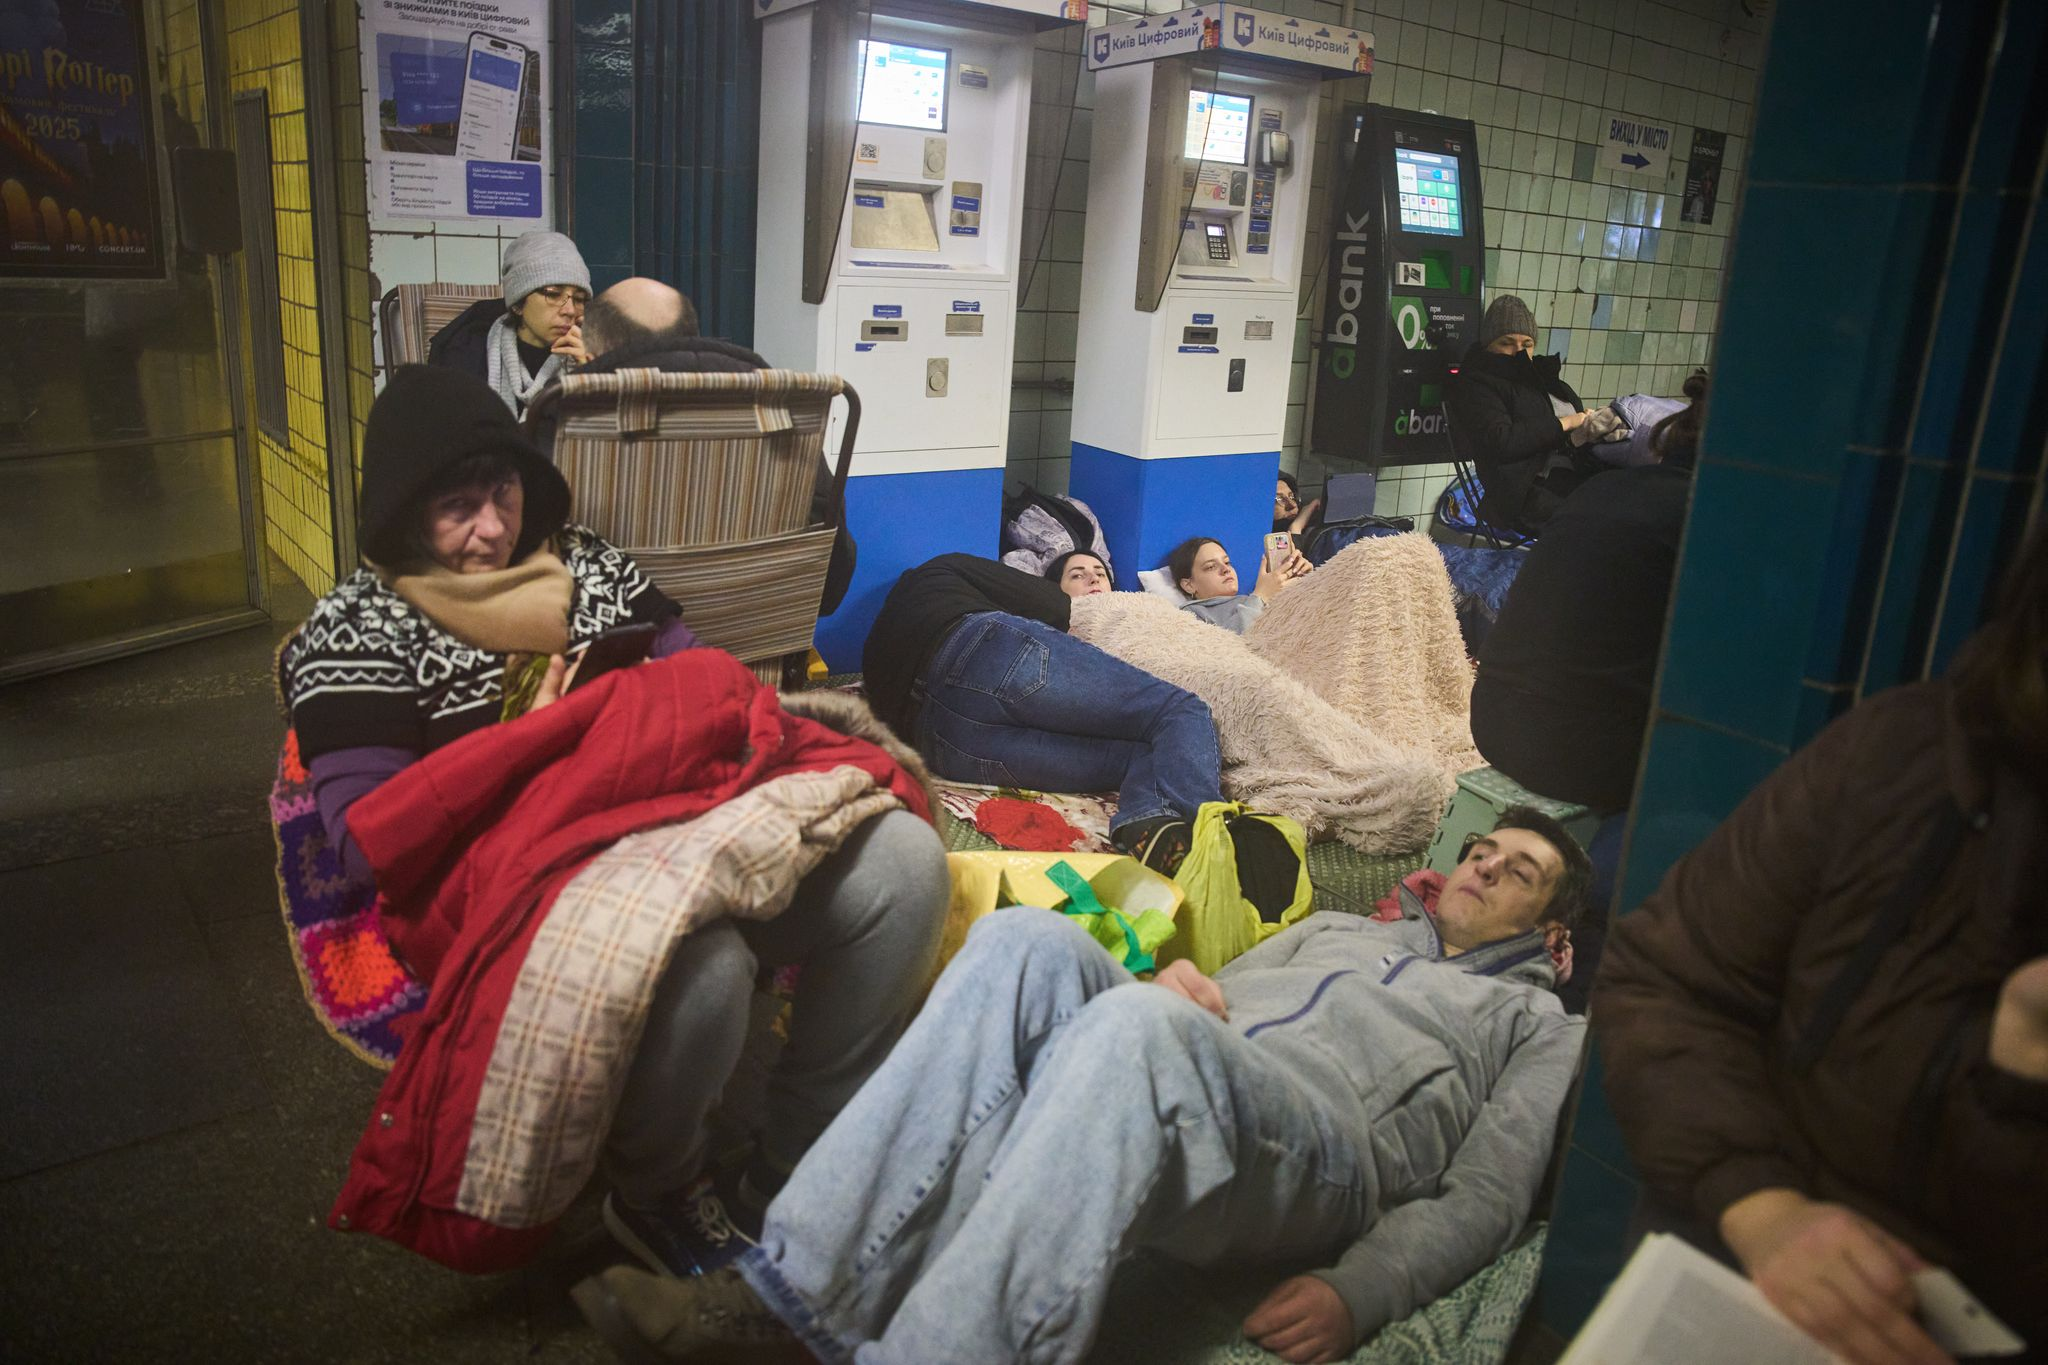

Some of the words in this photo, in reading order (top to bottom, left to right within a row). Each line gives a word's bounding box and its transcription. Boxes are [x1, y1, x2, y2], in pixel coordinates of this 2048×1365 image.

[394, 3, 450, 16] ЗНИЖКАМИ
[458, 10, 479, 20] КИЇВ
[480, 12, 530, 26] ЦИФРОВИЙ
[1112, 35, 1136, 51] Київ
[1138, 22, 1200, 47] Цифровий
[1258, 25, 1285, 43] Київ
[1288, 31, 1350, 55] Цифровий
[43, 46, 134, 107] Поттер
[24, 113, 81, 141] 2025
[1609, 118, 1636, 148] ВИХІД
[1635, 124, 1644, 145] У
[1641, 126, 1669, 151] МІСТО
[98, 245, 146, 253] CONCERT.UA
[1429, 305, 1442, 314] при
[1432, 313, 1465, 322] поповненні
